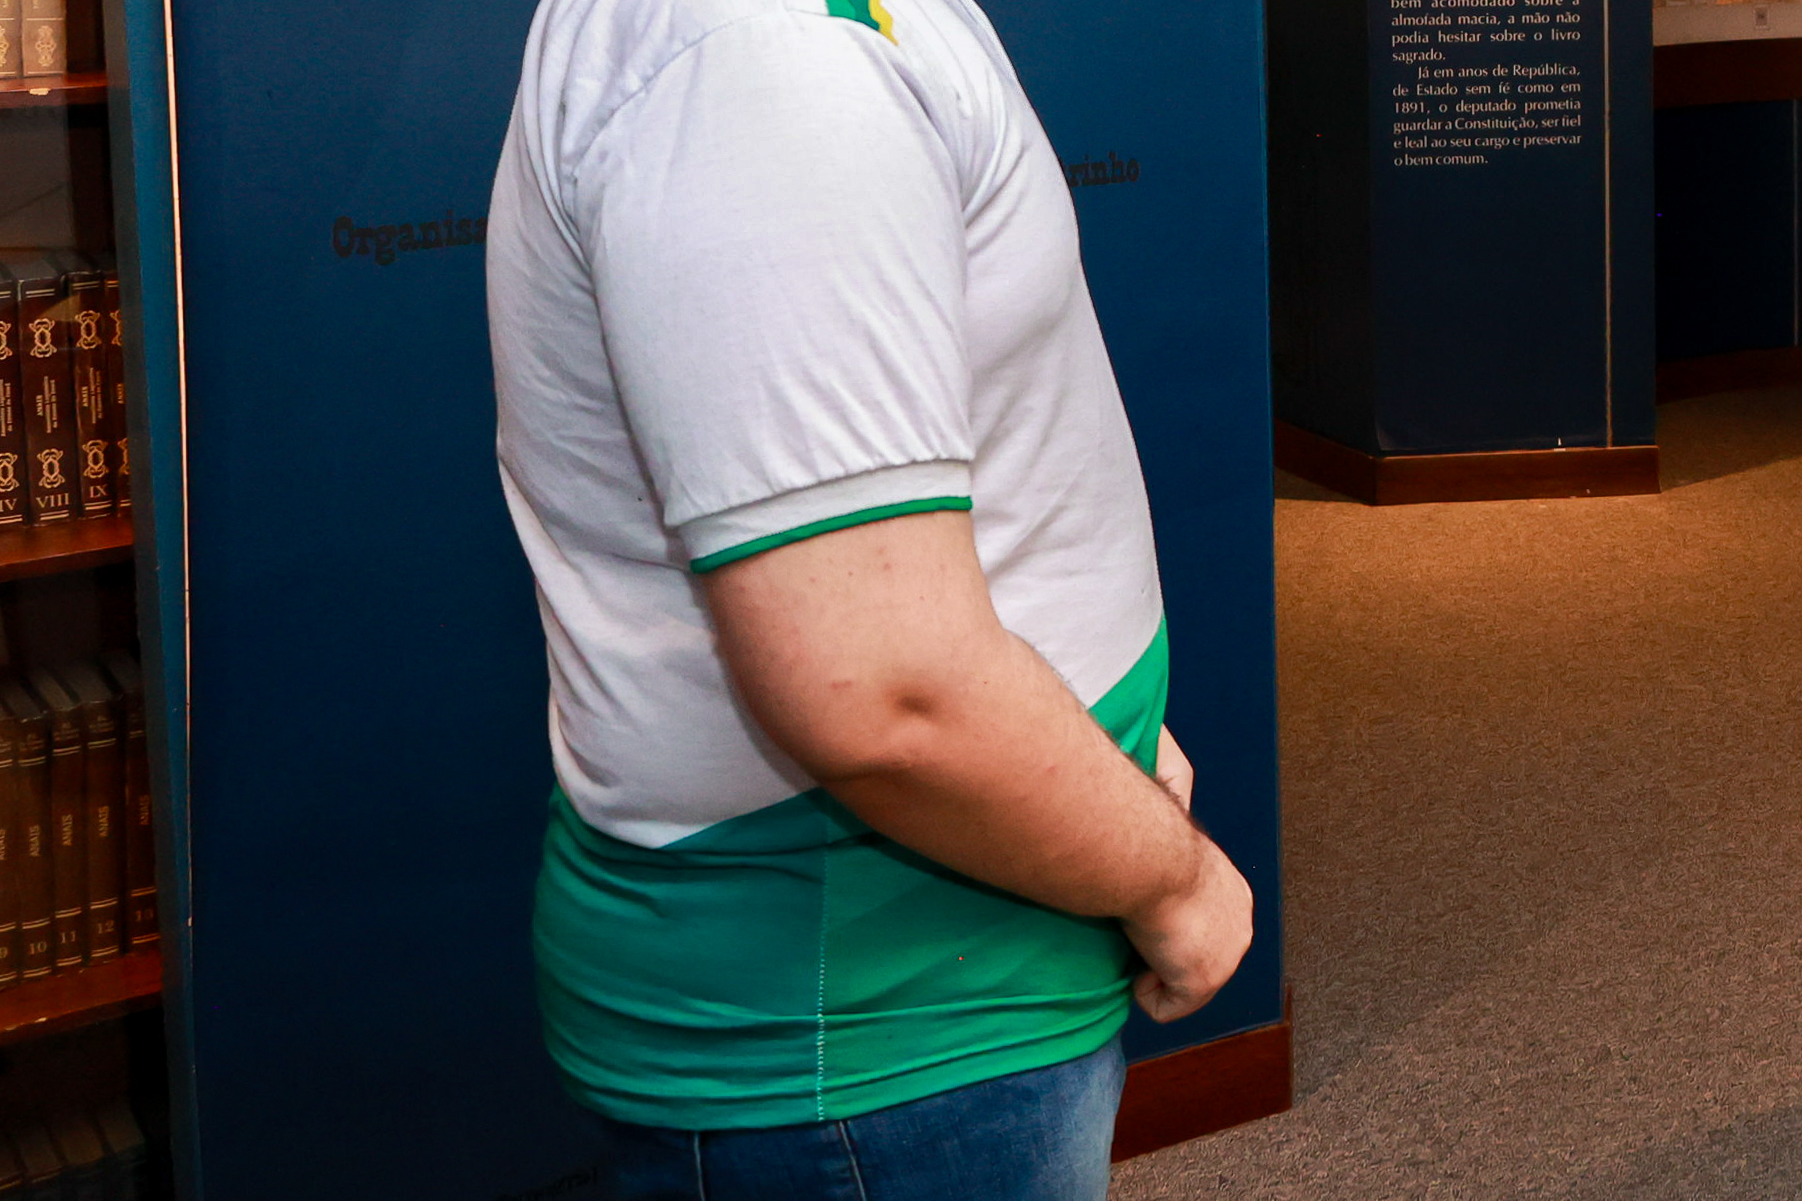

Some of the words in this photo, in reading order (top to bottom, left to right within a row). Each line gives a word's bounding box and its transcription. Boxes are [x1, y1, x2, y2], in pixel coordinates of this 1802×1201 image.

[1062, 151, 1141, 188] rinho
[89, 483, 109, 499] IX
[36, 492, 71, 509] VIII
[60, 930, 77, 945] 11
